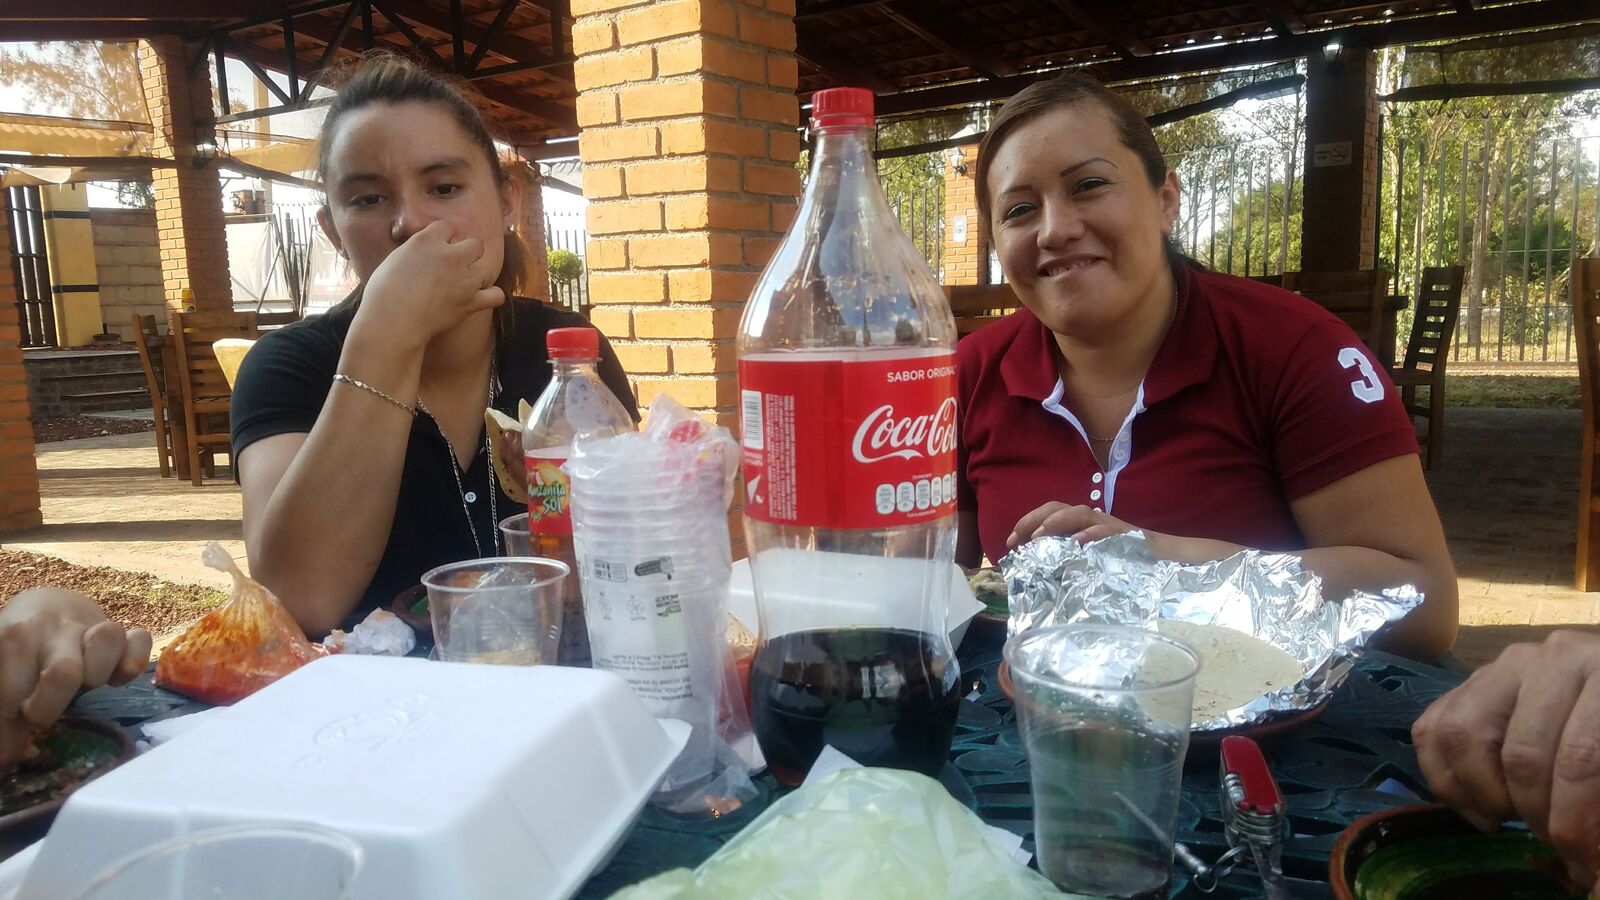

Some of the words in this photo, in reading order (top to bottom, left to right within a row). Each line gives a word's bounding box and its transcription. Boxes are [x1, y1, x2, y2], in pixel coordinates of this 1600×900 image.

[887, 369, 925, 382] SABOR
[1338, 347, 1385, 403] 3
[852, 396, 958, 464] Coca-Col
